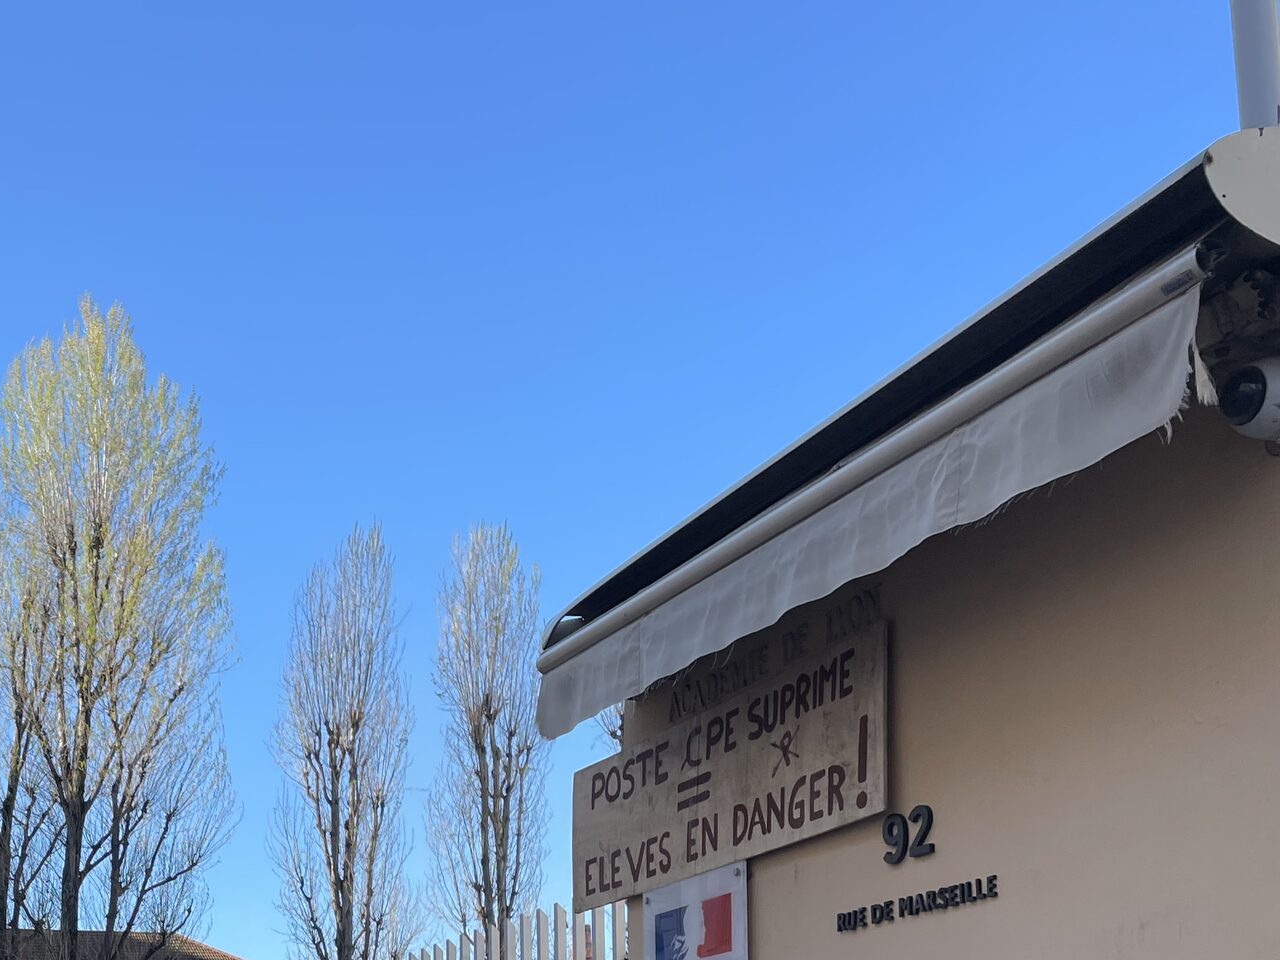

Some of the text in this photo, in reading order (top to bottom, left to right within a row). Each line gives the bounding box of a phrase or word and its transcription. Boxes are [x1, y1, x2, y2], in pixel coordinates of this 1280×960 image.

[591, 647, 855, 810] POSTE CPE SUPRIME
[585, 831, 670, 896] ELEVES
[686, 813, 718, 863] EN
[882, 805, 936, 865] 92
[836, 874, 999, 932] RUE DE MARSEILLE
